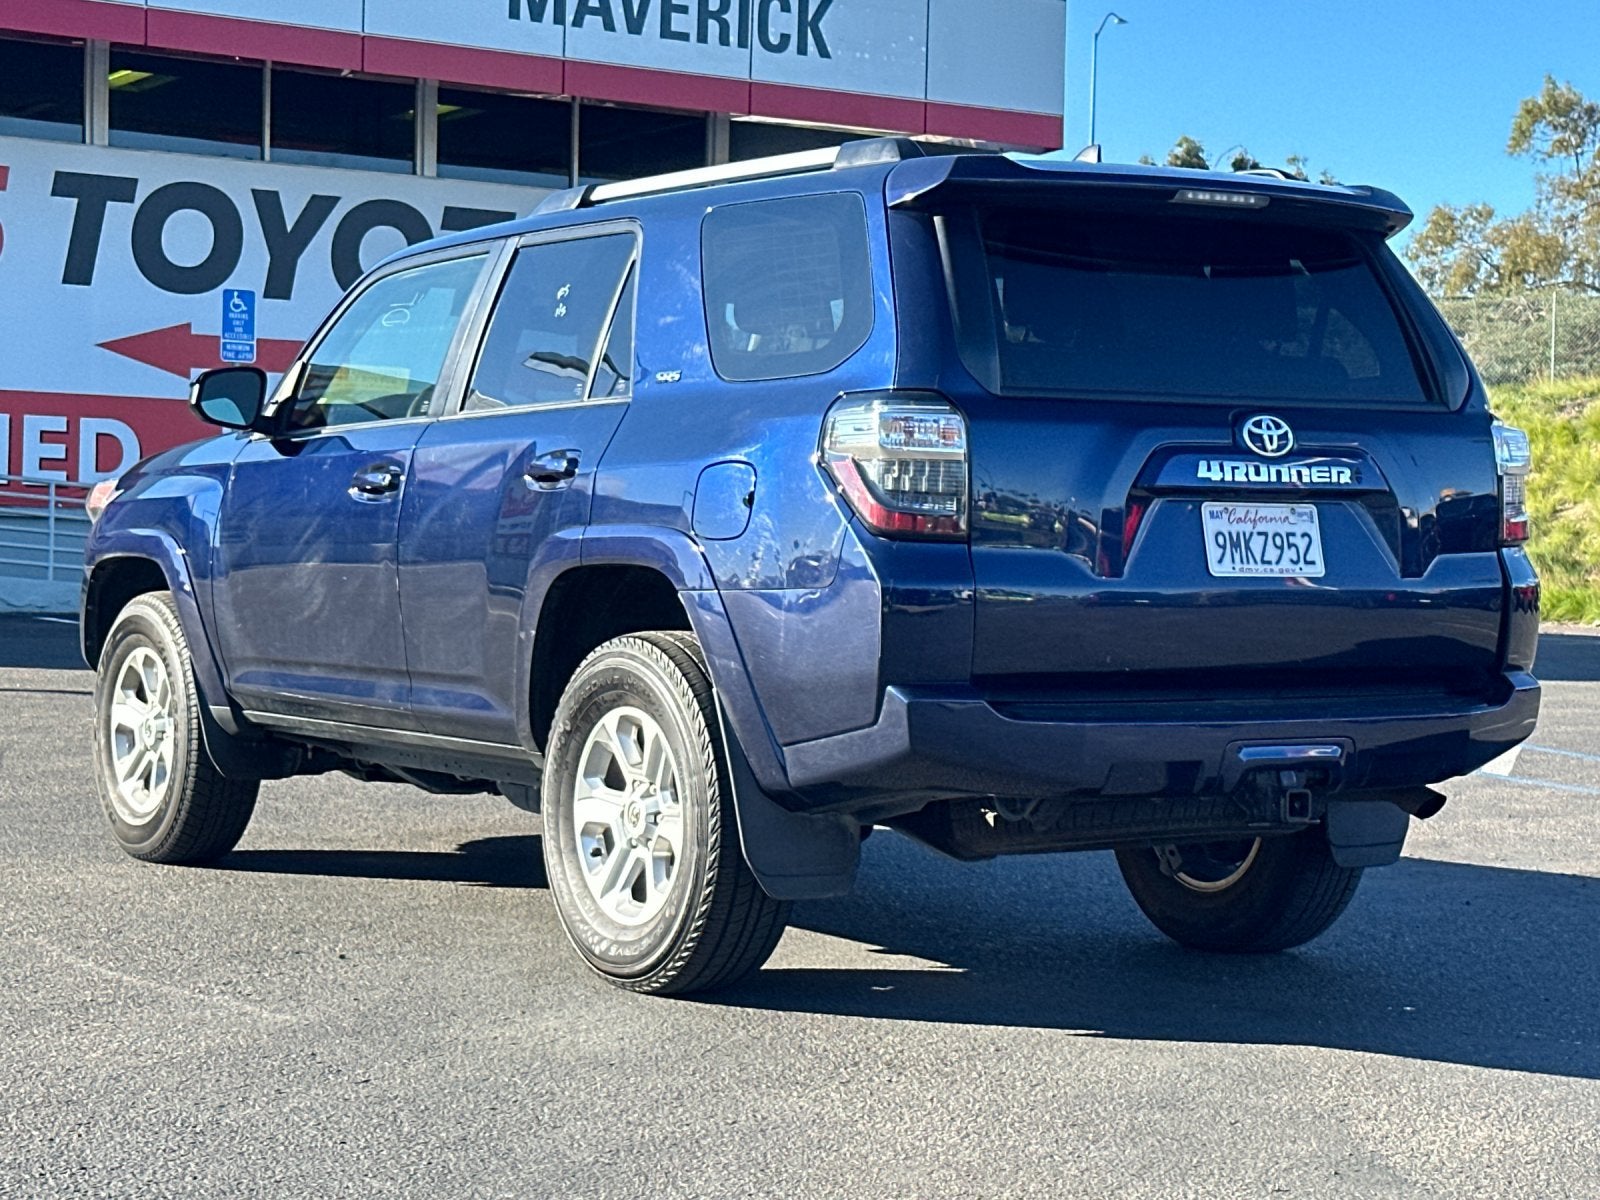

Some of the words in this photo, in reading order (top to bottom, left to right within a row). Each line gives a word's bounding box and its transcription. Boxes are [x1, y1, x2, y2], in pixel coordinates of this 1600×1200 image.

[51, 171, 517, 301] TOYO
[1197, 460, 1352, 484] 4RUNNER
[1209, 509, 1224, 520] MAY
[1227, 507, 1298, 529] California
[1214, 531, 1316, 566] 9MKZ952
